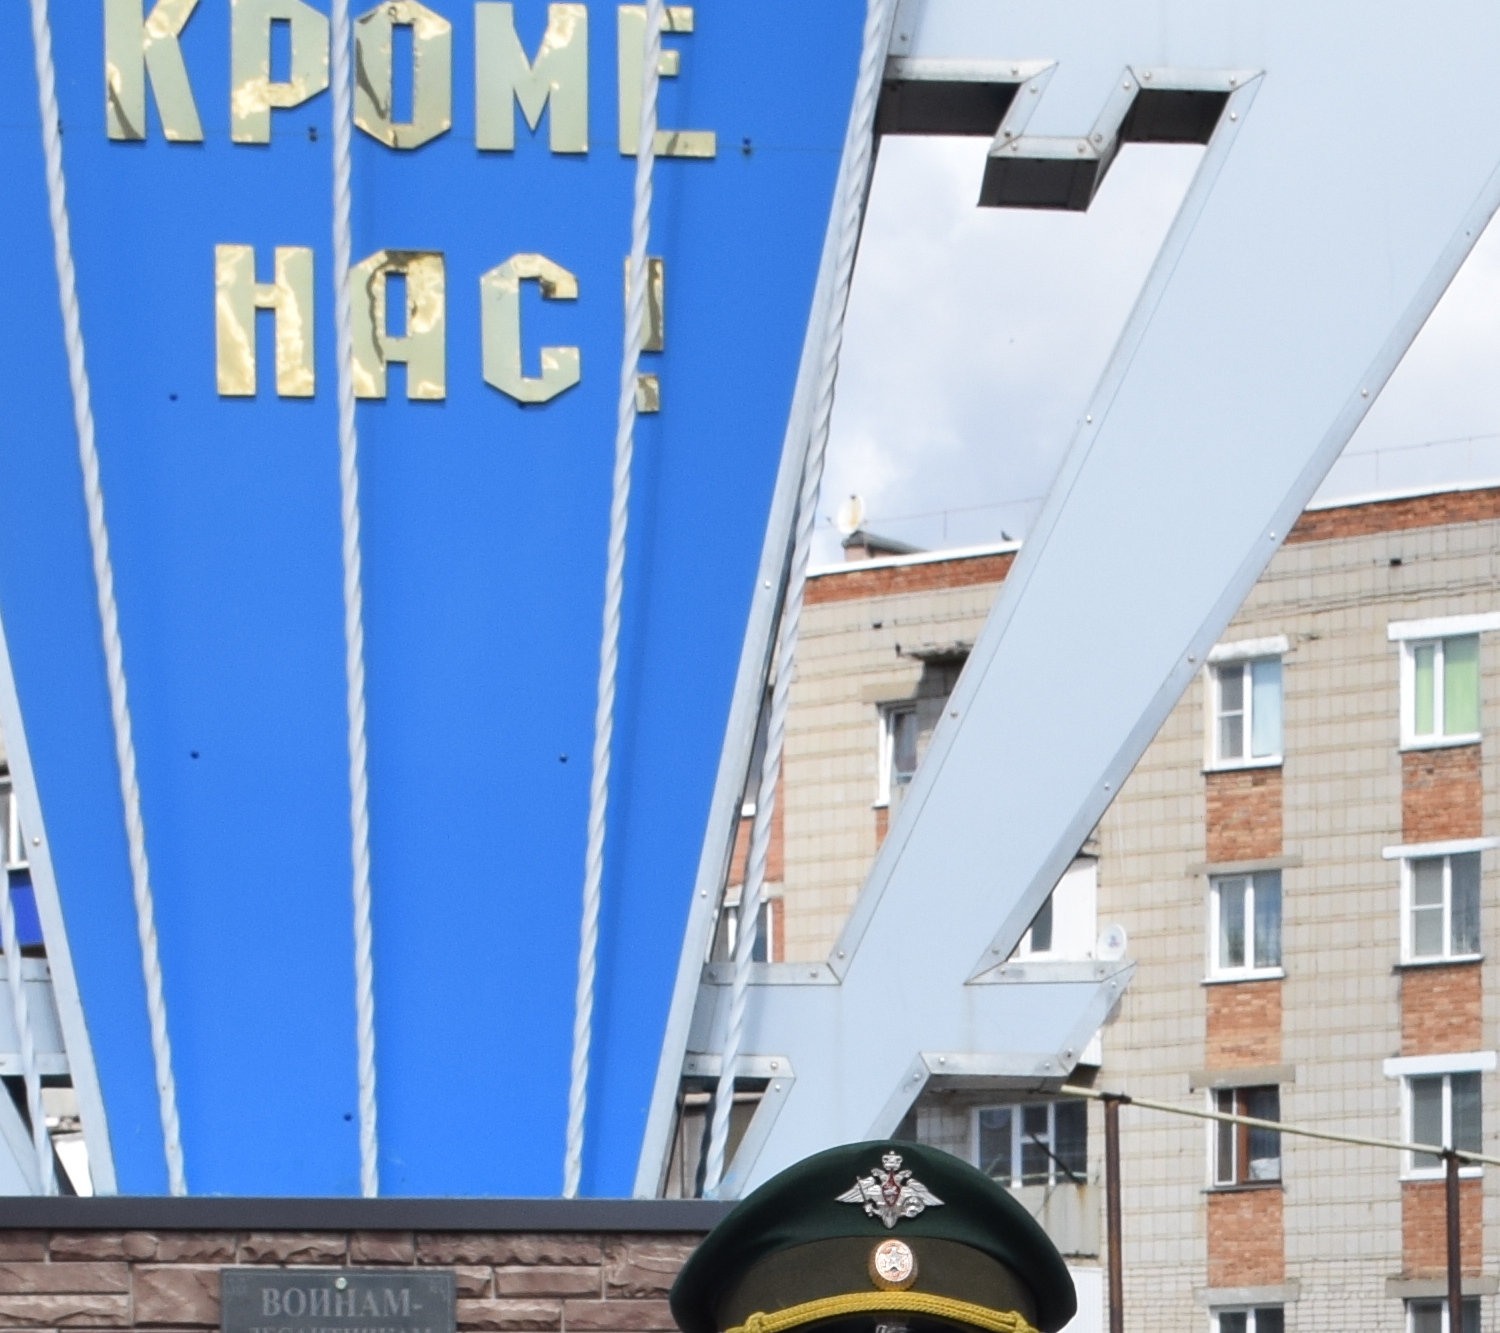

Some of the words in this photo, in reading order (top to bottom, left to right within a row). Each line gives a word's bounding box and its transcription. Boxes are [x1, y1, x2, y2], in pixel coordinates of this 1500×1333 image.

[104, 0, 716, 157] КРОМЕ
[215, 244, 664, 413] НАС!
[262, 1287, 423, 1317] ВОИНАМ-
